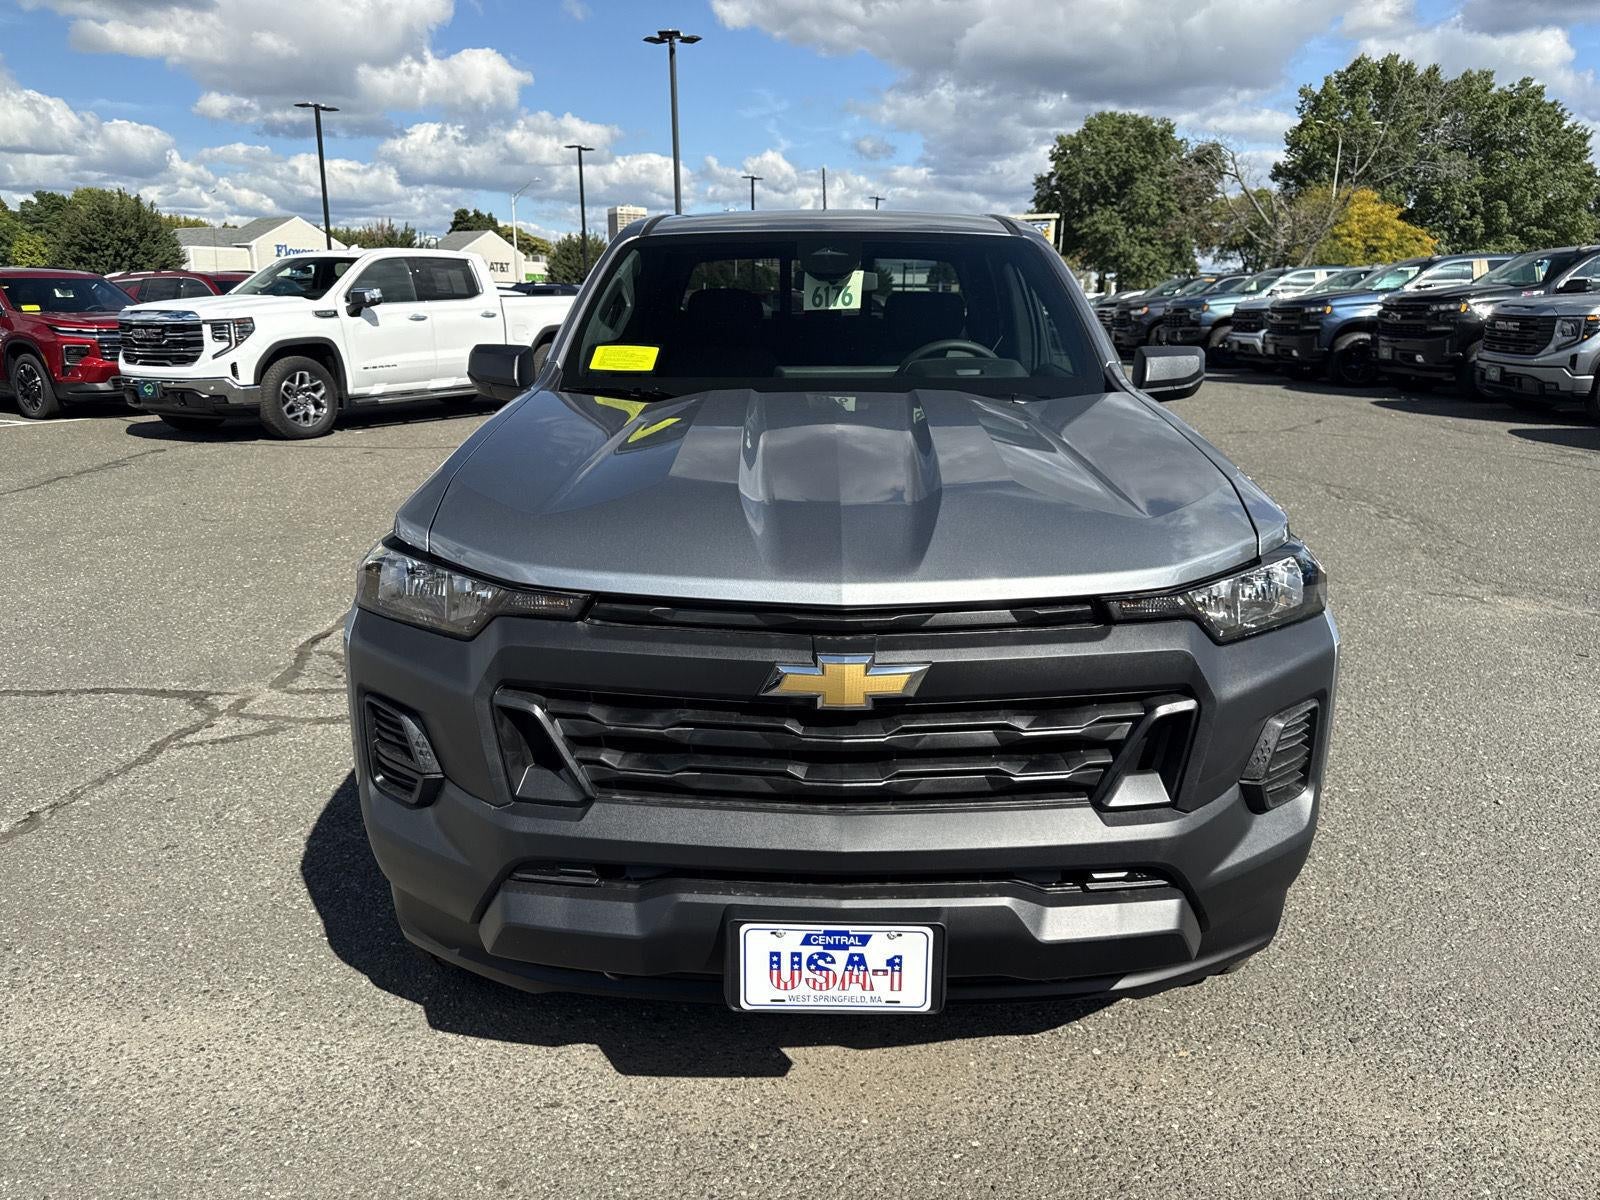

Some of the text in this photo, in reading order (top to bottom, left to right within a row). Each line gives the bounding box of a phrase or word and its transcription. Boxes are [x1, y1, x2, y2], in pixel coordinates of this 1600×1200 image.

[489, 261, 510, 273] AT&T
[811, 285, 853, 308] 6176
[1495, 320, 1520, 331] GMC
[131, 328, 163, 339] GMC
[810, 935, 863, 946] CENTRAL
[769, 951, 903, 992] USA-1
[788, 994, 883, 1005] WEST SPRINGFIELD, MA
